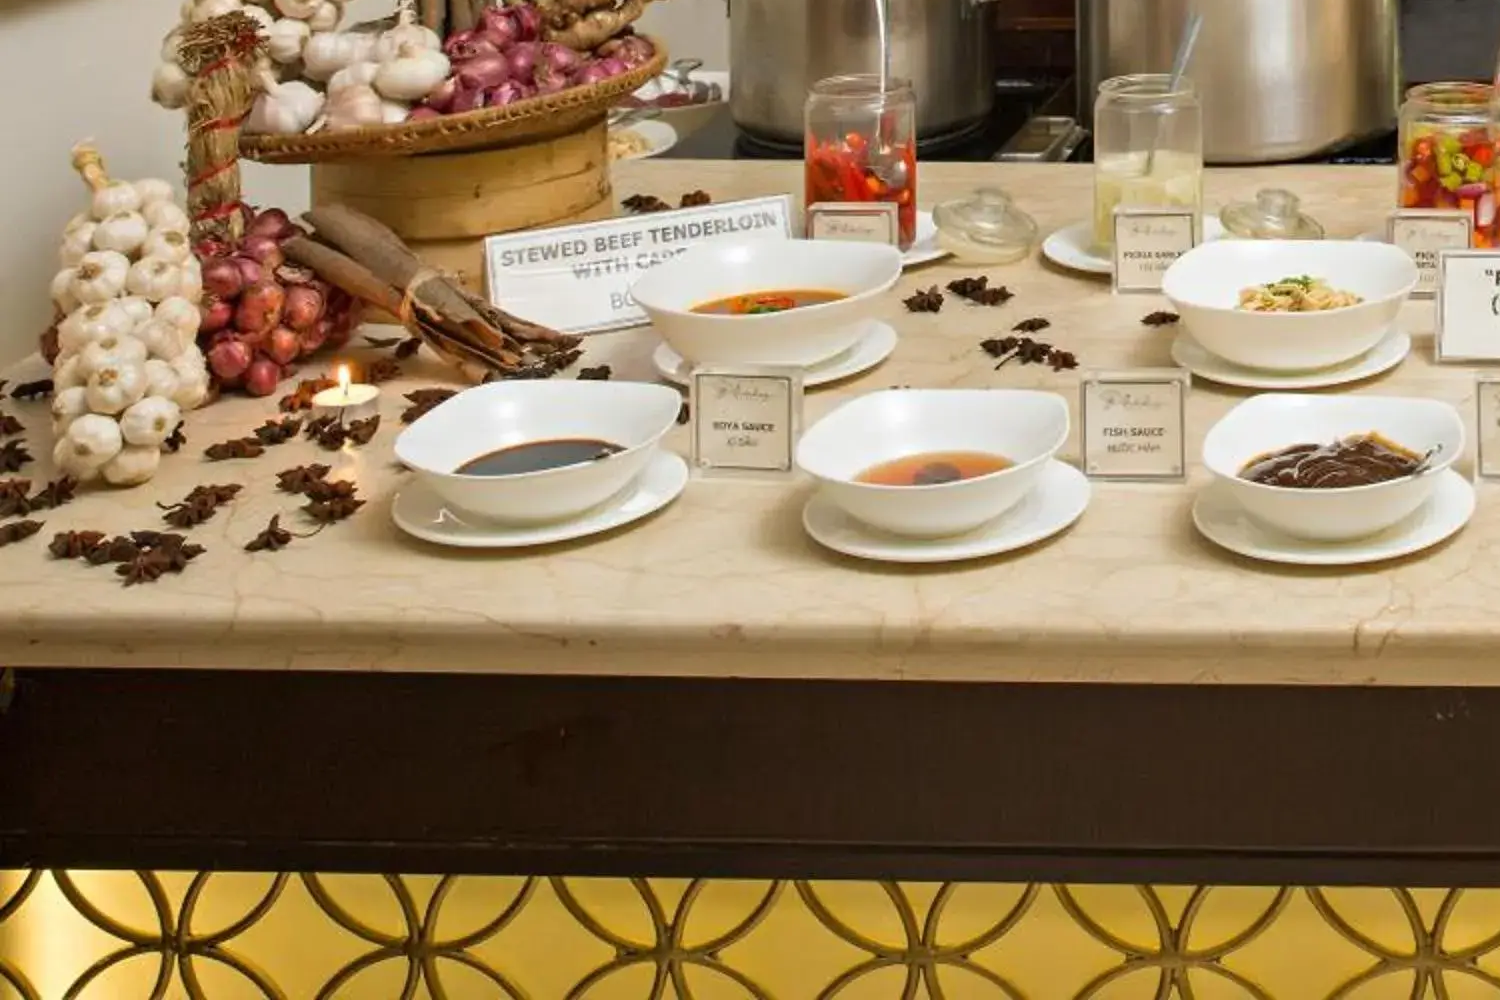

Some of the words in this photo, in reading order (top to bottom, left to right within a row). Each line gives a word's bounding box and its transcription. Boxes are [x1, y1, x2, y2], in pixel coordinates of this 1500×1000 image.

[500, 238, 588, 267] STEWED
[594, 231, 643, 252] BEEF
[649, 211, 777, 244] TENDERLOIN
[572, 255, 630, 279] WITH
[635, 247, 688, 268] CA
[1130, 427, 1164, 437] SAUCE
